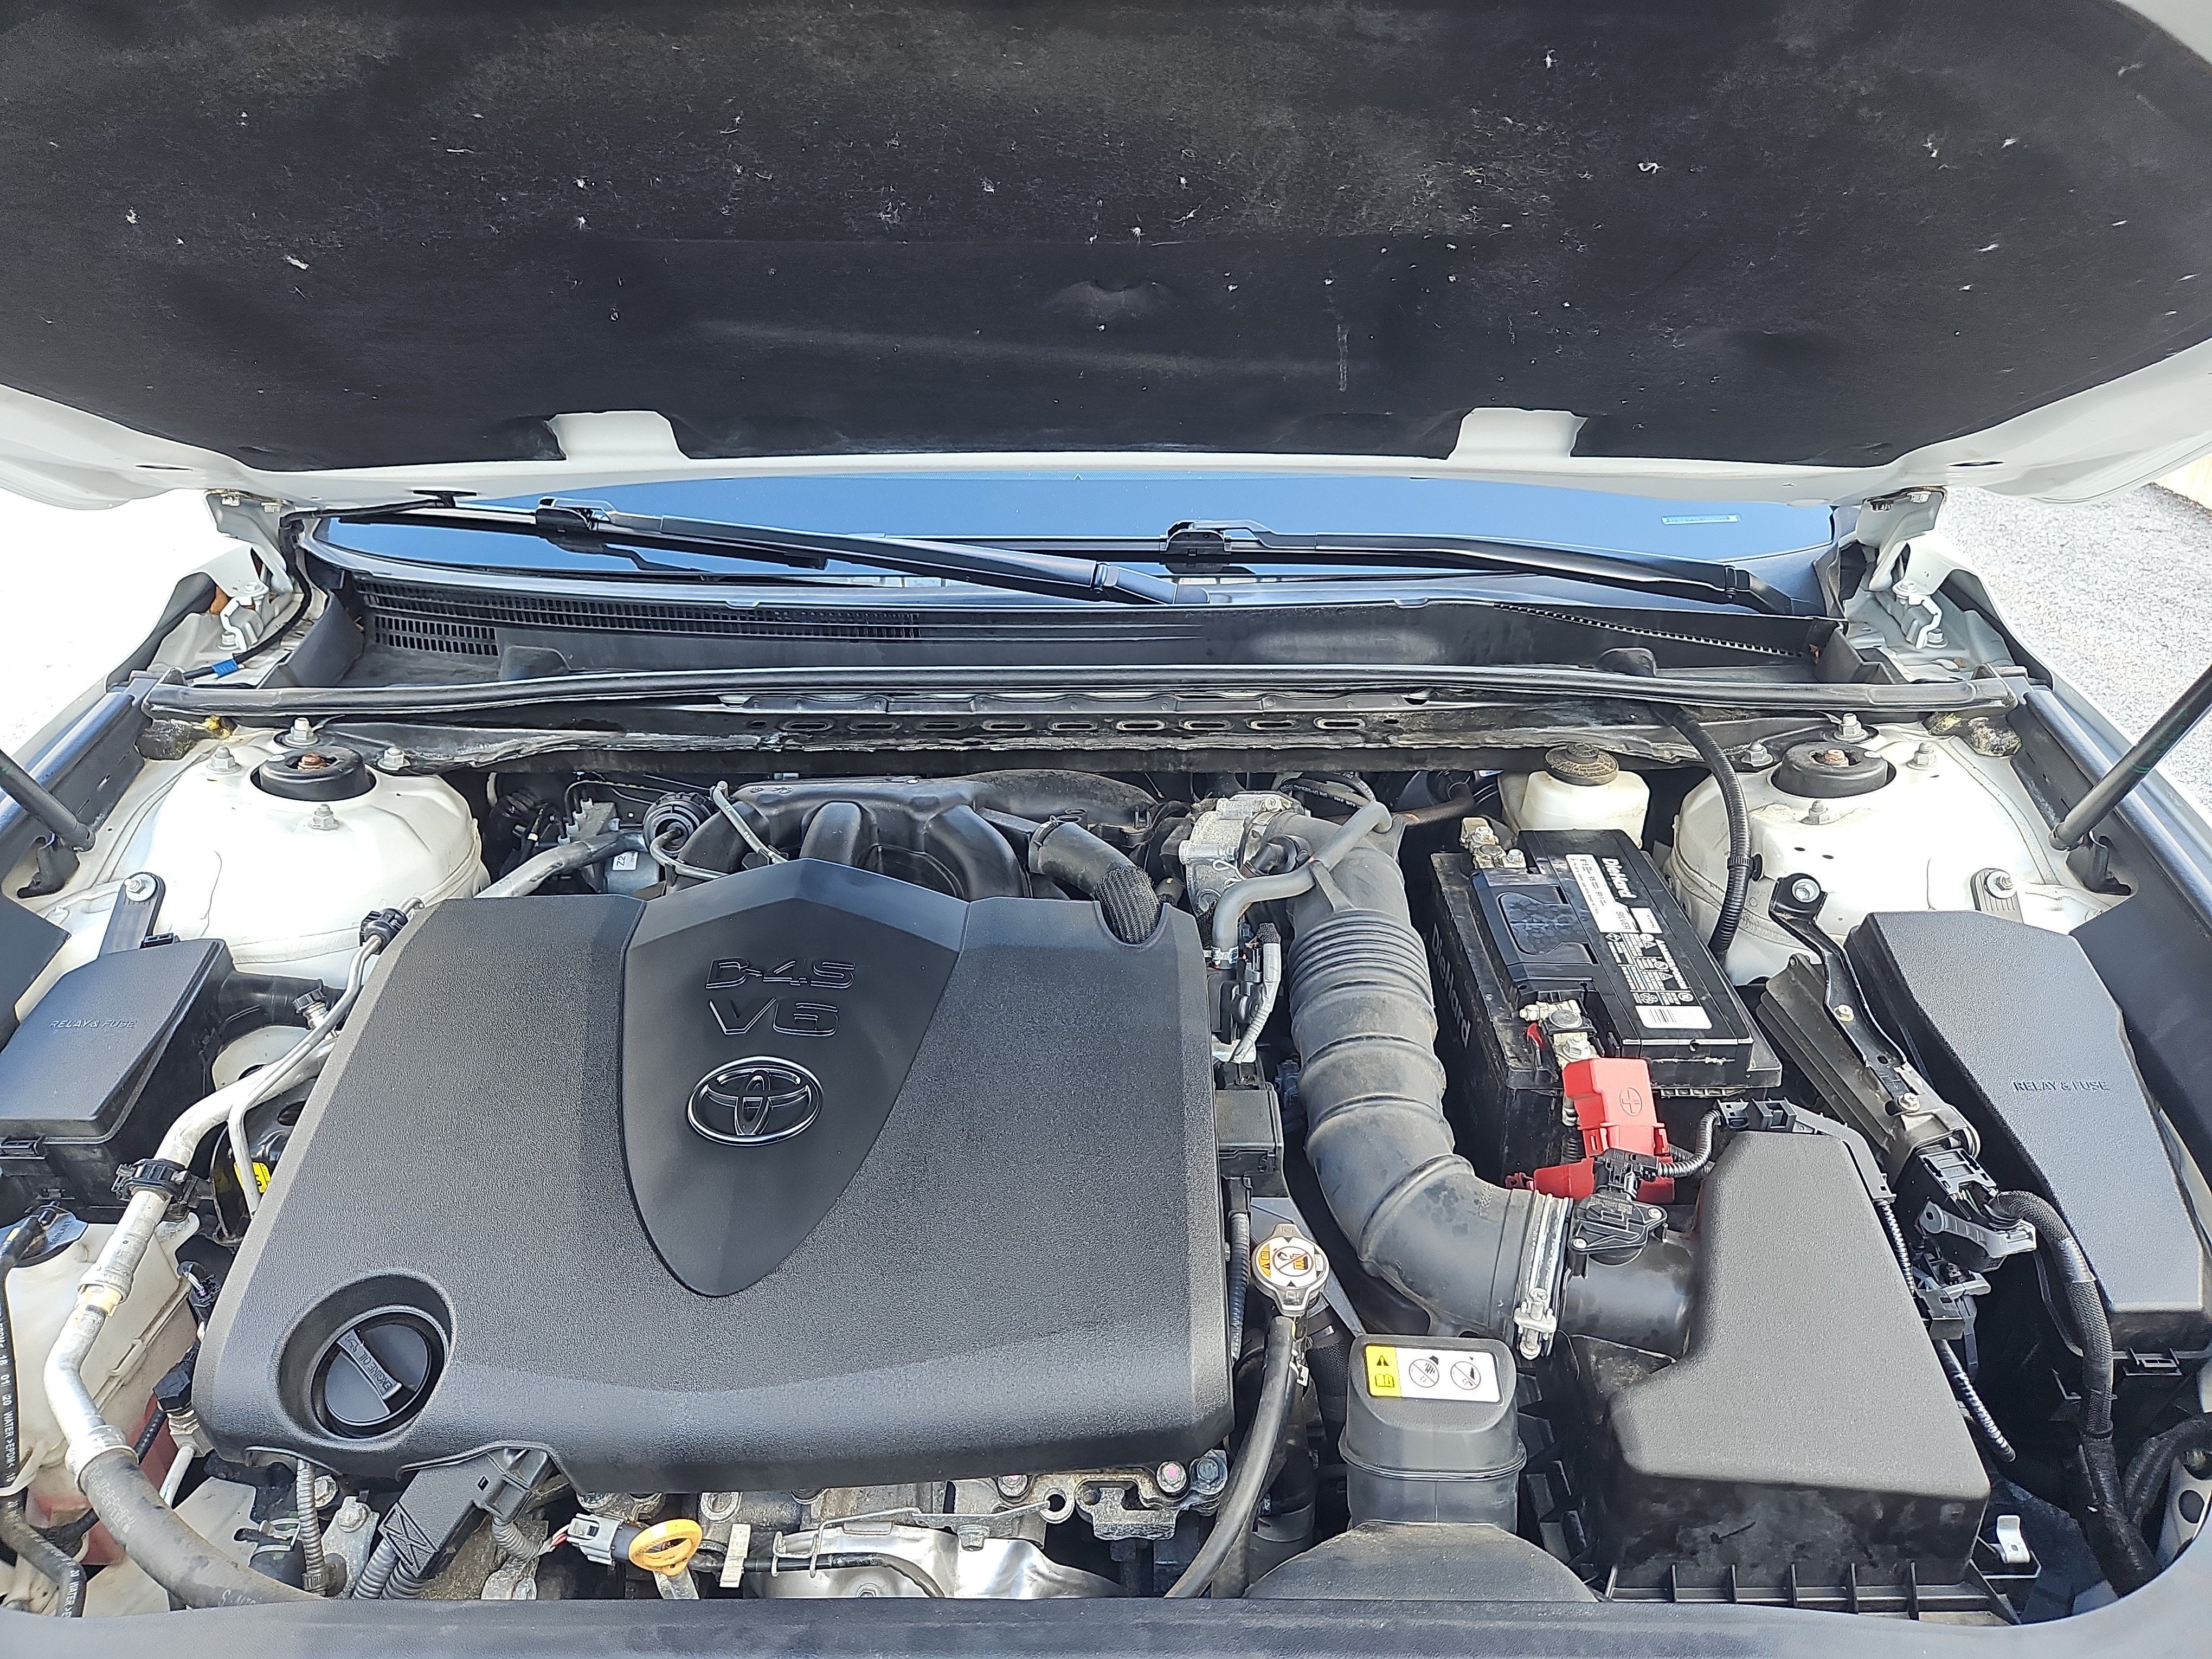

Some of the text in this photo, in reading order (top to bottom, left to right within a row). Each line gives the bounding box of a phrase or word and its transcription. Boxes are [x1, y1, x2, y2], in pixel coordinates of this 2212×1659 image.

[1601, 858, 1638, 898] DieHard
[1616, 911, 1631, 930] SILVER
[705, 957, 856, 989] D-4S
[1432, 923, 1470, 1049] DieHard
[49, 1020, 136, 1028] RELAY & FUSE
[708, 996, 839, 1036] V6
[2012, 1081, 2110, 1091] RELAY & FUSE
[359, 1351, 393, 1391] ENGINE OIL
